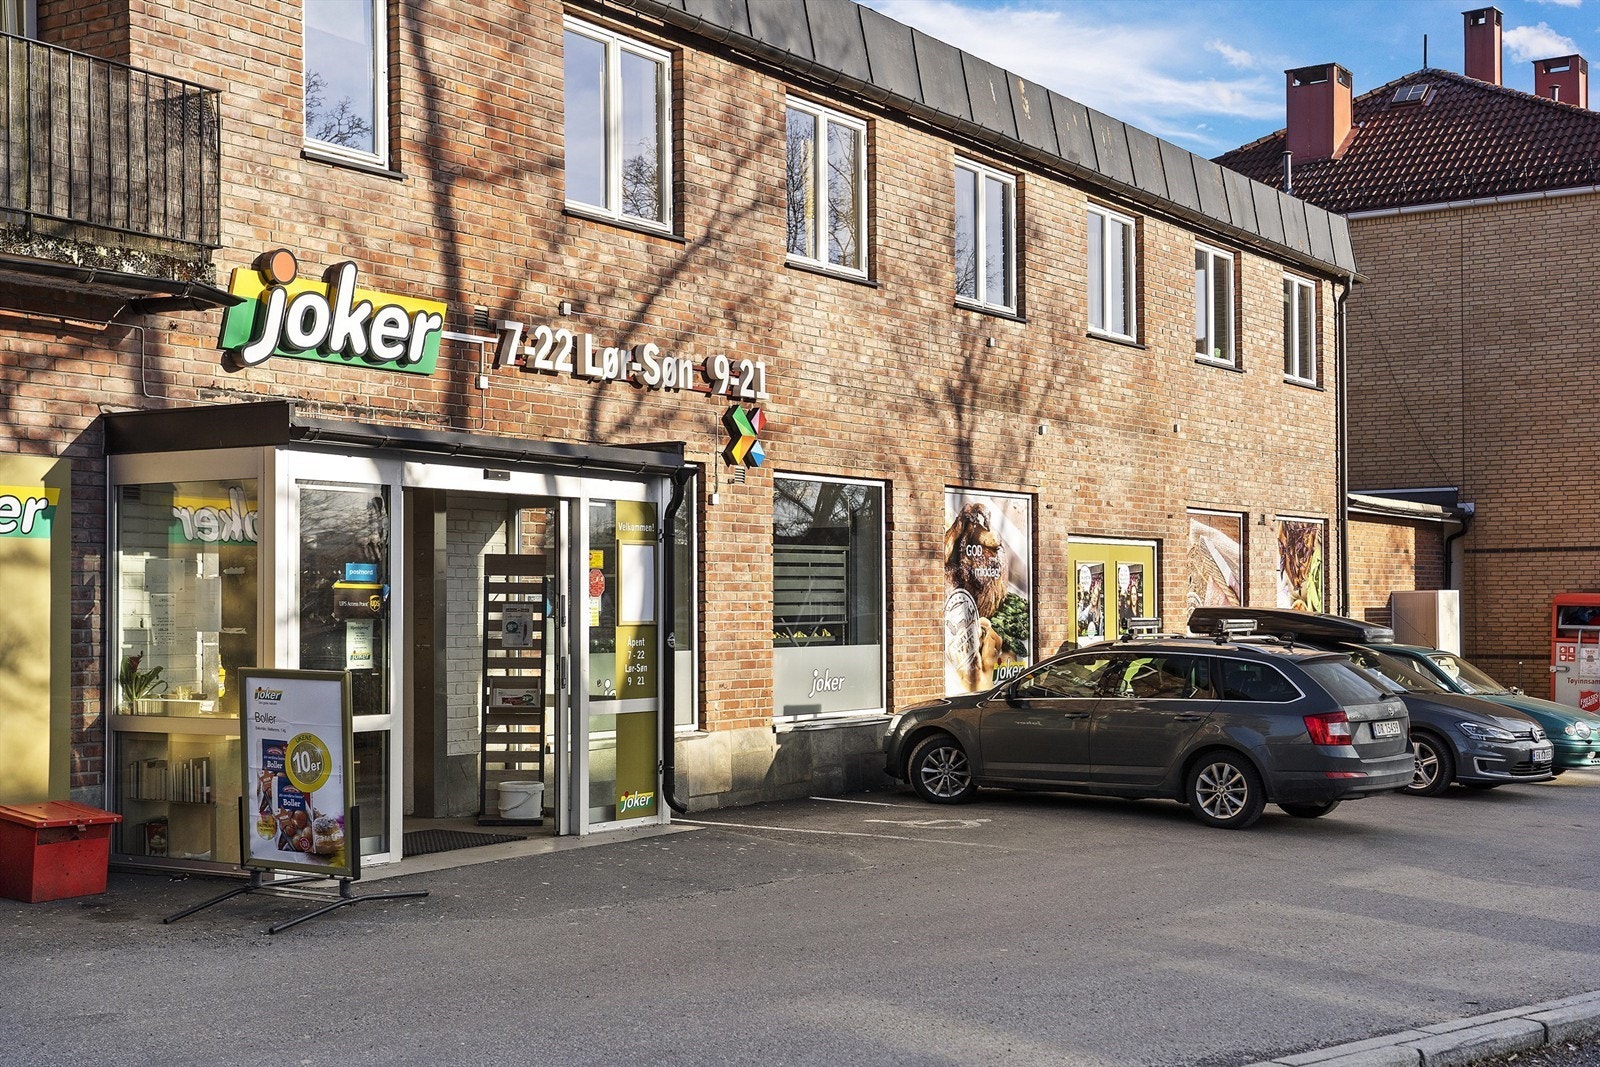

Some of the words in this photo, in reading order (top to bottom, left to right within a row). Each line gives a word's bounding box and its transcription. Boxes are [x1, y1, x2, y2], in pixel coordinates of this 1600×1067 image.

[240, 248, 444, 367] joker
[498, 320, 573, 372] 7-22
[577, 332, 693, 391] Lør-Søn
[706, 354, 770, 400] 9-21
[618, 522, 655, 532] Velkommen!
[966, 544, 983, 557] GOD
[349, 568, 374, 576] postnord
[637, 650, 645, 660] 22
[624, 663, 648, 673] Lør-Søn
[993, 657, 1024, 685] joker
[627, 676, 632, 686] 9
[637, 676, 645, 685] 21
[808, 668, 846, 698] joker
[255, 687, 281, 701] joker
[254, 711, 277, 724] Boller
[266, 760, 283, 769] Boller
[292, 750, 321, 773] 10er
[282, 798, 301, 808] Boller
[620, 790, 653, 813] joker
